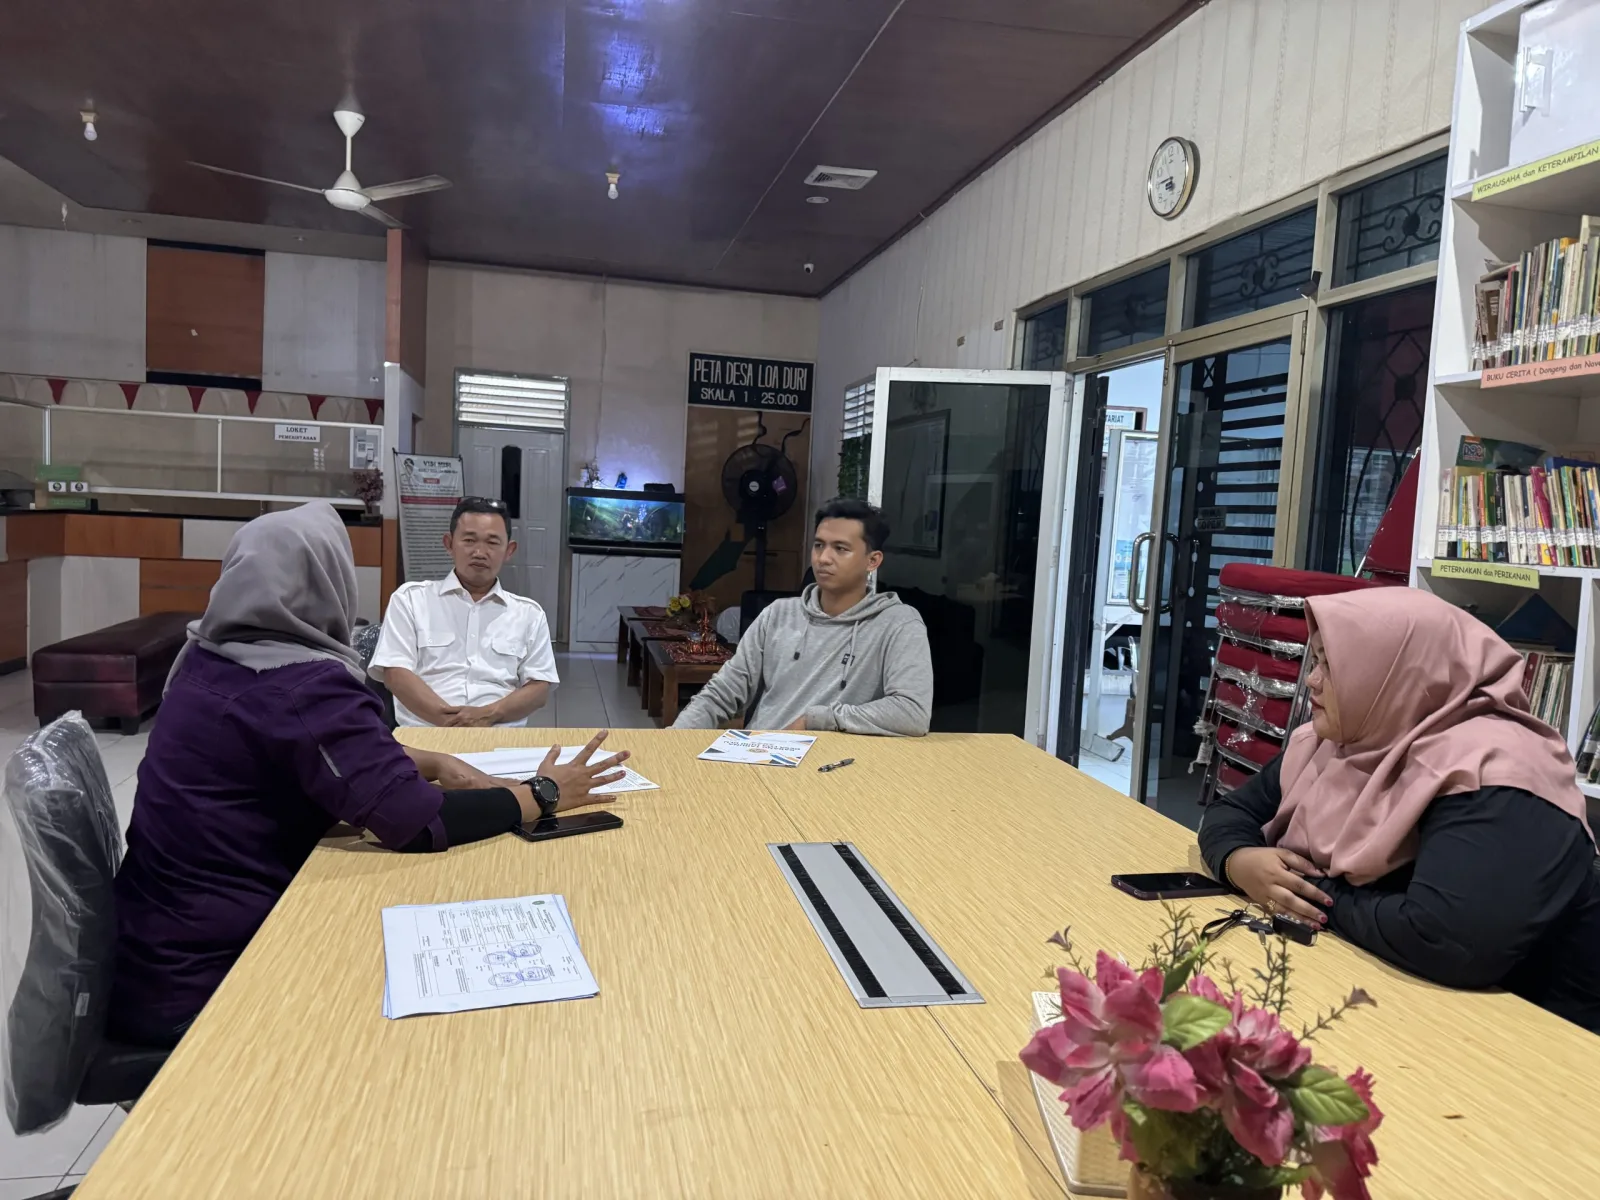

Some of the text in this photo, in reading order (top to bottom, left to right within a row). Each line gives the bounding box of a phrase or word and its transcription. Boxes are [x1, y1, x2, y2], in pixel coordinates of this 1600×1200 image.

[1477, 146, 1599, 193] WIRAUSAHA dan KETERAMPILAN
[693, 358, 808, 391] PETA DESA LOA DURI
[1486, 373, 1504, 382] BUKU
[1506, 369, 1531, 379] CERITA
[1539, 366, 1567, 375] Dongeng
[1569, 362, 1582, 370] dan
[700, 387, 736, 402] SKALA
[743, 390, 748, 402] 1
[760, 392, 799, 406] 25.000
[1440, 564, 1531, 582] PETERNAKAN dan PERIKANAN
